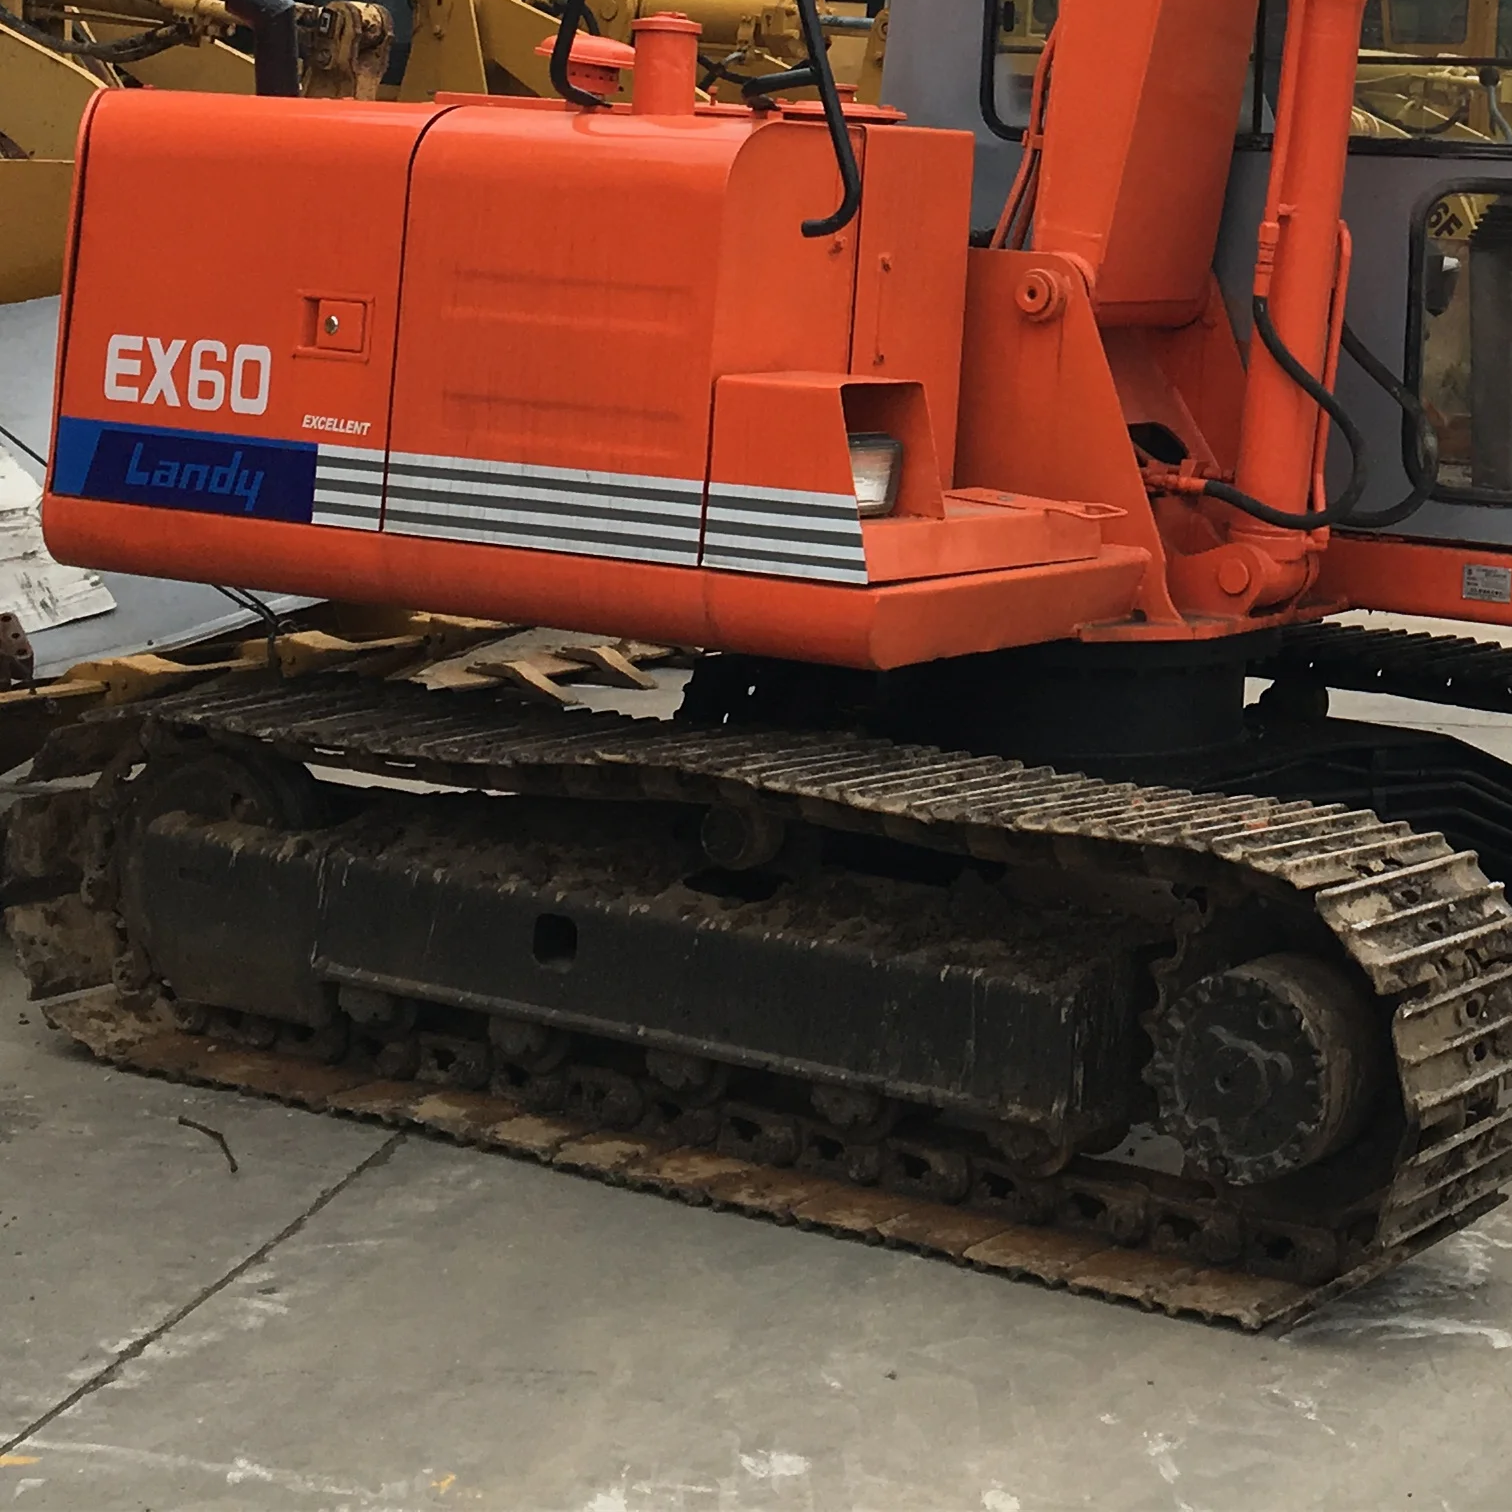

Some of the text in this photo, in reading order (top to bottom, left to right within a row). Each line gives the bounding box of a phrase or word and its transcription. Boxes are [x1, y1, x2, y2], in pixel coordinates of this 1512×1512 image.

[104, 334, 271, 415] EX60
[301, 414, 371, 436] EXCELLENT
[124, 442, 264, 511] Landy
